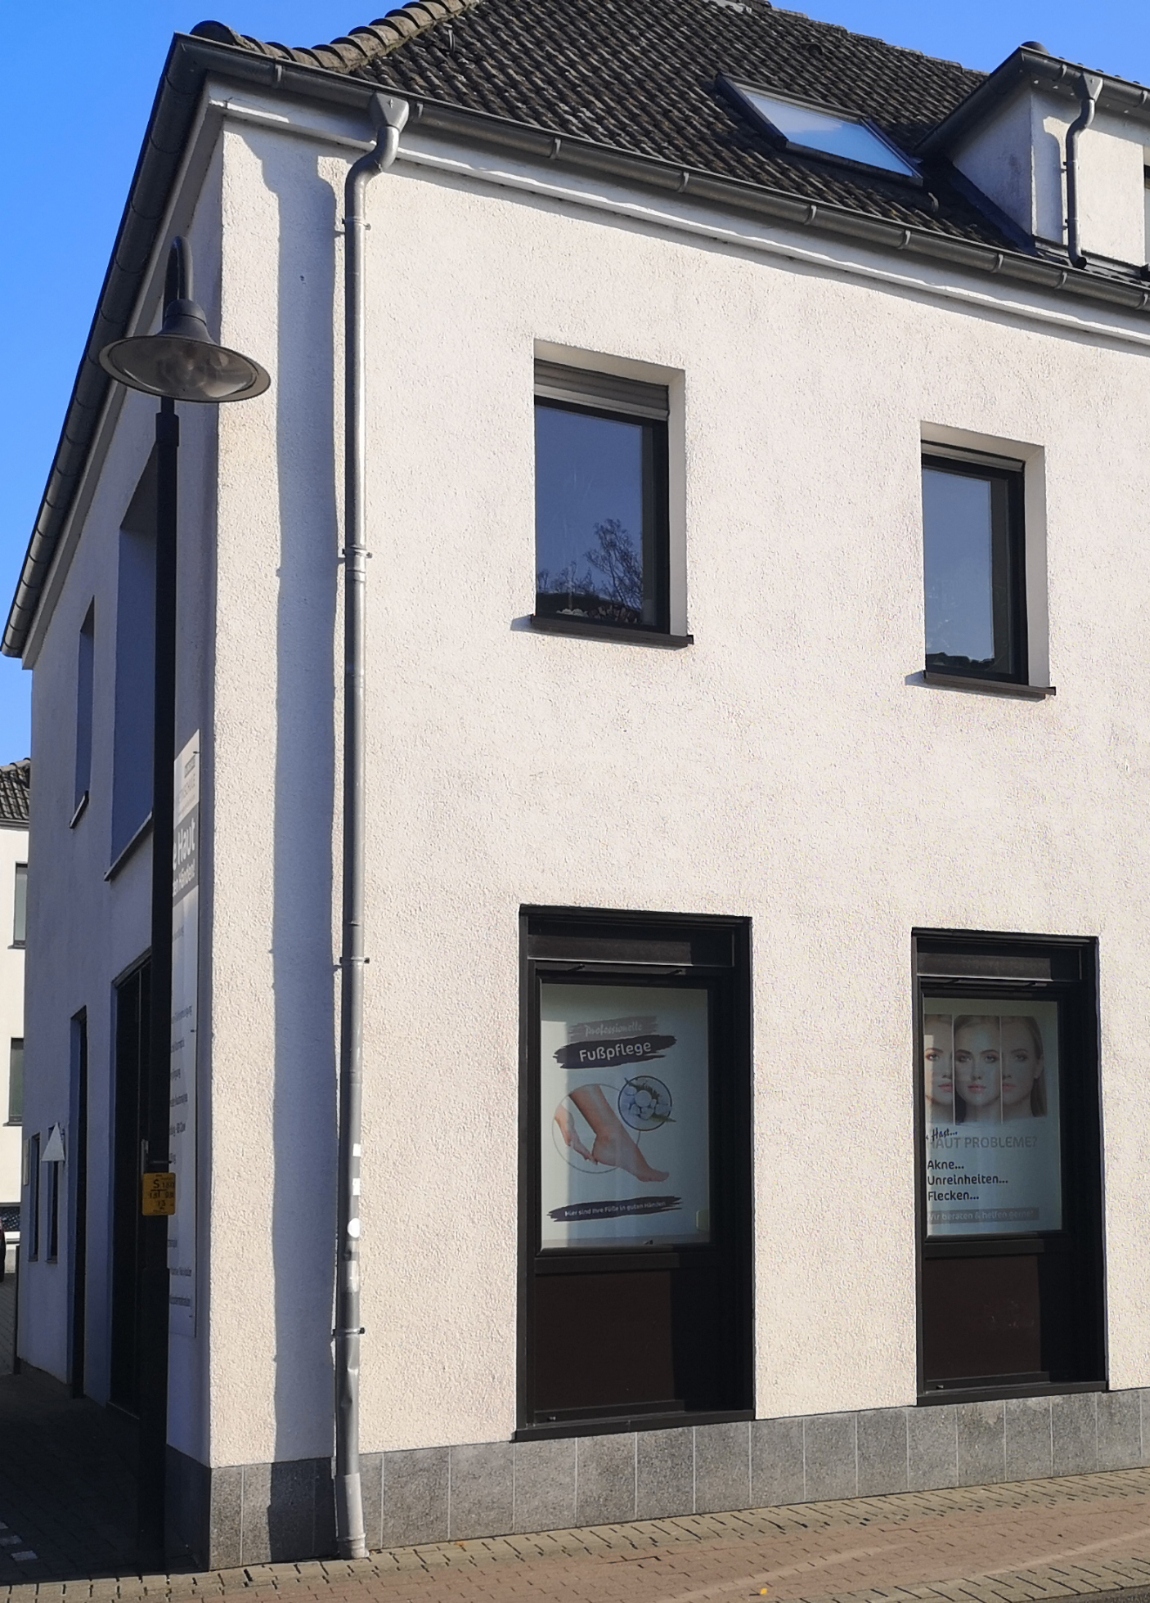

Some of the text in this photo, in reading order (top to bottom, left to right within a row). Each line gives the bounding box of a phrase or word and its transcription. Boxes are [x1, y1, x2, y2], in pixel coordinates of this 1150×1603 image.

[178, 817, 195, 865] Haut
[585, 1020, 643, 1037] Professionelle
[579, 1042, 651, 1062] Fußpflege
[928, 1135, 1038, 1149] HAUT PROBLEME?
[927, 1159, 964, 1170] Akne...
[153, 1179, 160, 1188] S
[927, 1174, 1008, 1185] Unreinheiten...
[928, 1190, 979, 1201] Flecken...
[627, 1204, 643, 1212] guten
[928, 1211, 940, 1221] Wir
[941, 1211, 973, 1220] beraten
[974, 1211, 981, 1219] &
[982, 1210, 1008, 1219] helfen
